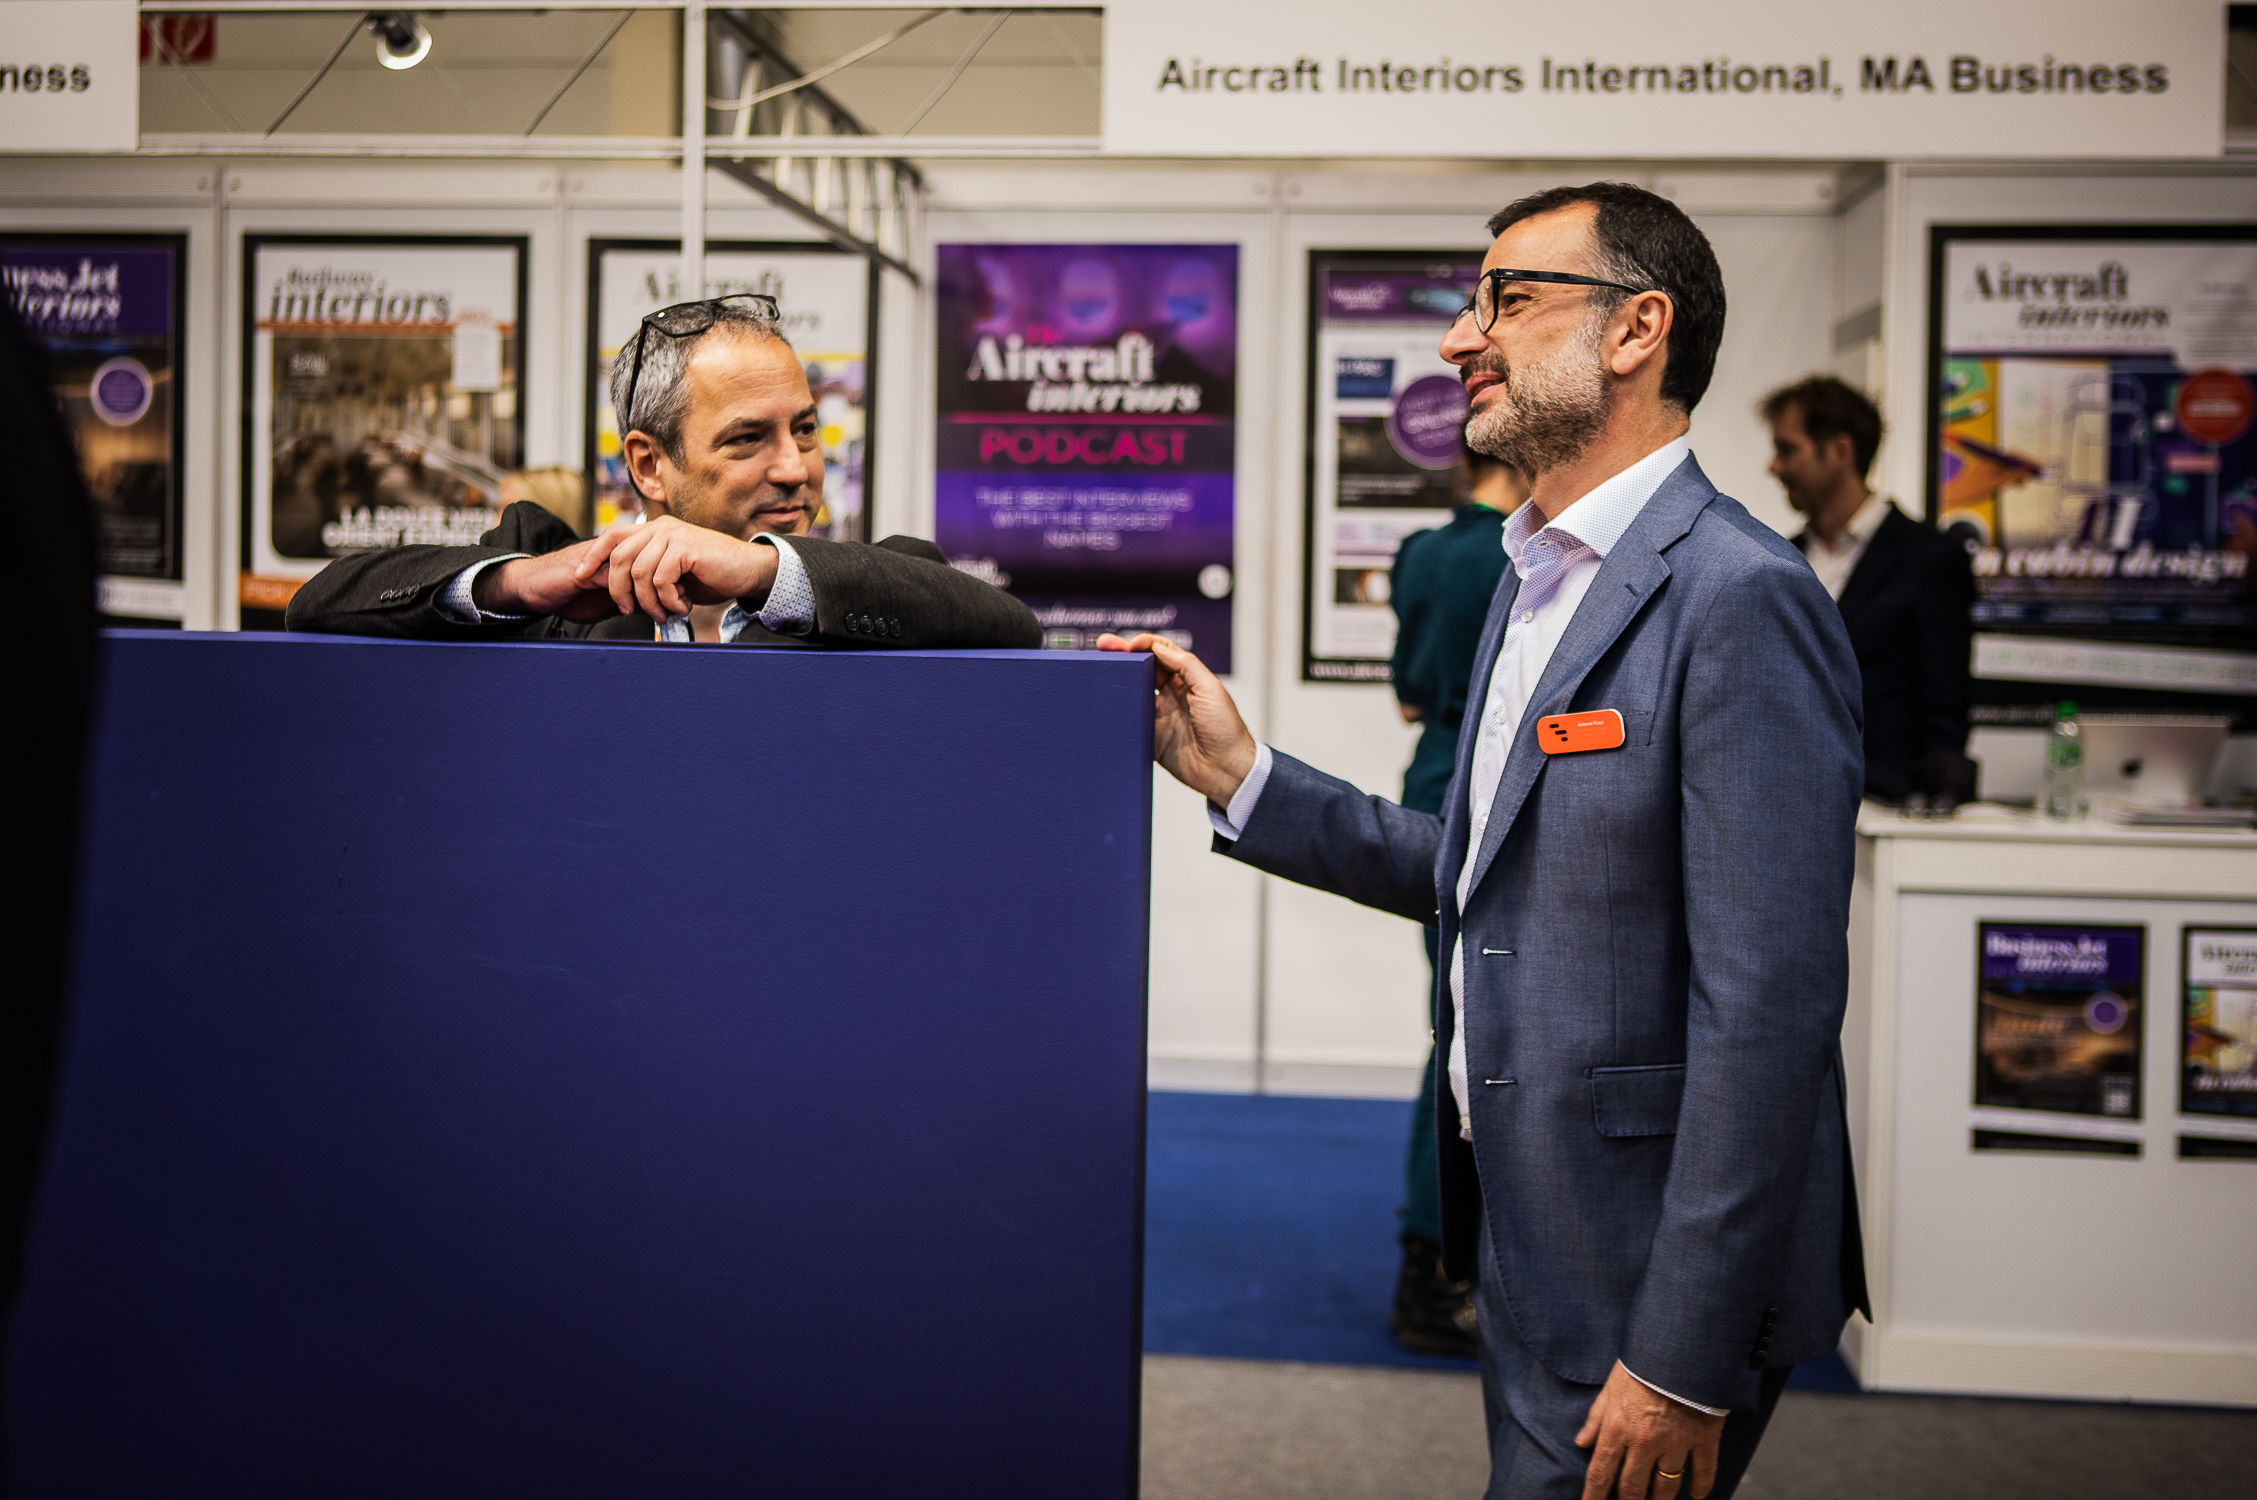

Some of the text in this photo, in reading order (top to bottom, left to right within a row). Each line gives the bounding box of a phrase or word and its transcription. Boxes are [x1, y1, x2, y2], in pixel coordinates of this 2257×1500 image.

[1158, 55, 2170, 99] Aircraft Interiors International, MA Business
[1964, 261, 2130, 300] Aircraft
[271, 279, 451, 325] interiors
[2018, 301, 2171, 330] interiors
[966, 332, 1154, 382] Aircraft
[1026, 377, 1203, 414] interiors
[980, 427, 1187, 466] PODCAST
[2005, 541, 2117, 578] cabin
[2119, 541, 2250, 587] design
